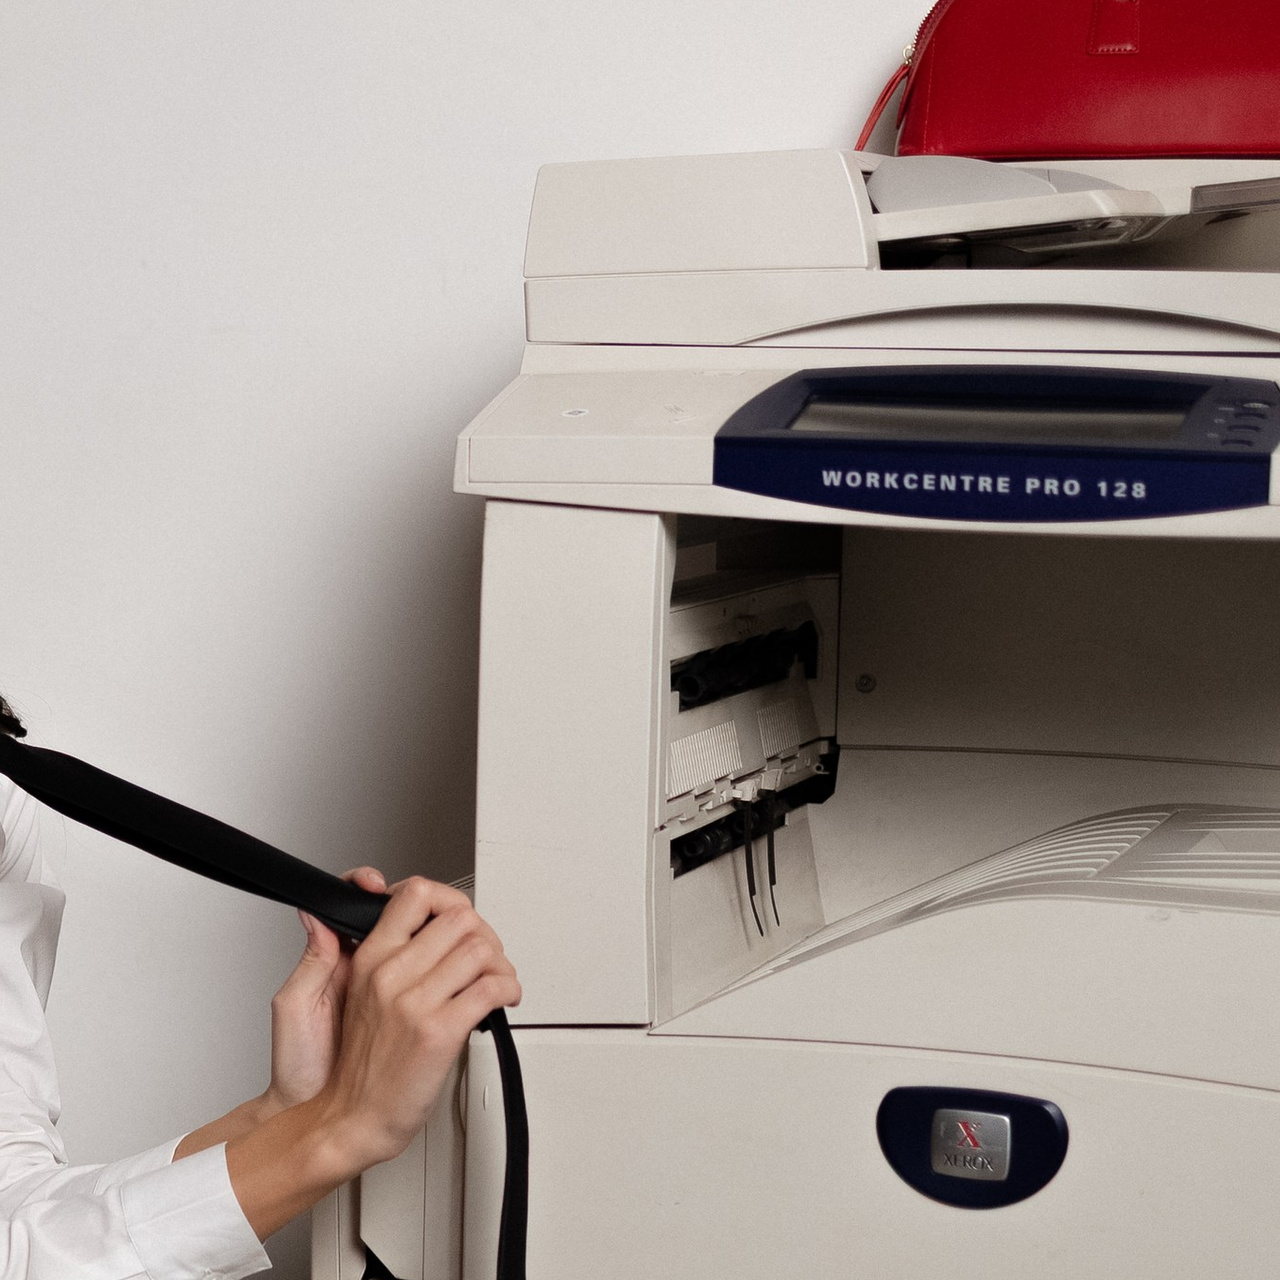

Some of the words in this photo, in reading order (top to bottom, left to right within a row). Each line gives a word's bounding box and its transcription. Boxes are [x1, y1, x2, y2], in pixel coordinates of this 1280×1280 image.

[822, 470, 1011, 494] WORKCENTRE
[1024, 476, 1082, 497] PRO
[1096, 480, 1148, 500] 128
[943, 1153, 994, 1172] XEROX
